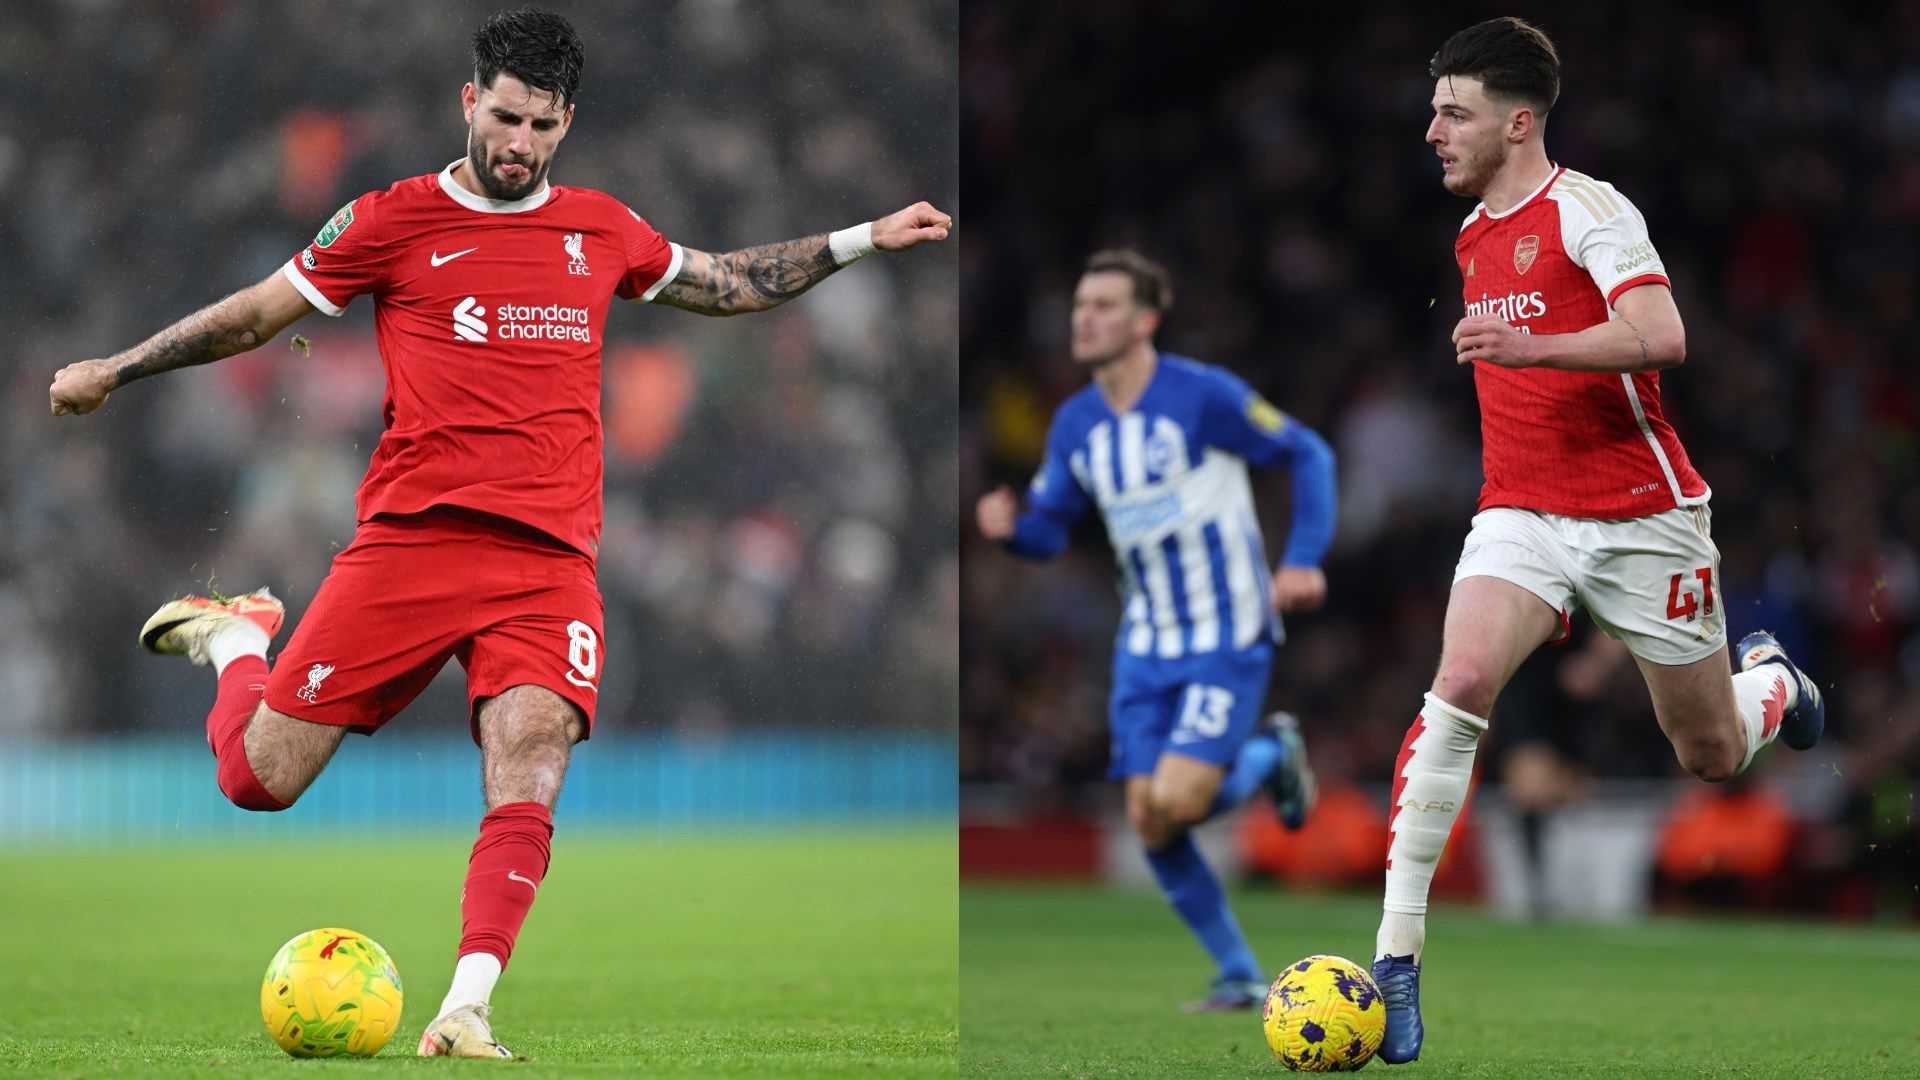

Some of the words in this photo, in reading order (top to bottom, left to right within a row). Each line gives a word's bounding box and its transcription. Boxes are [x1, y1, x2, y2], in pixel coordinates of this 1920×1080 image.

[498, 303, 588, 324] standard
[1465, 291, 1546, 321] mirates
[498, 321, 590, 343] chartered
[1667, 567, 1712, 622] 41
[567, 620, 596, 679] 8
[1179, 684, 1234, 737] 13
